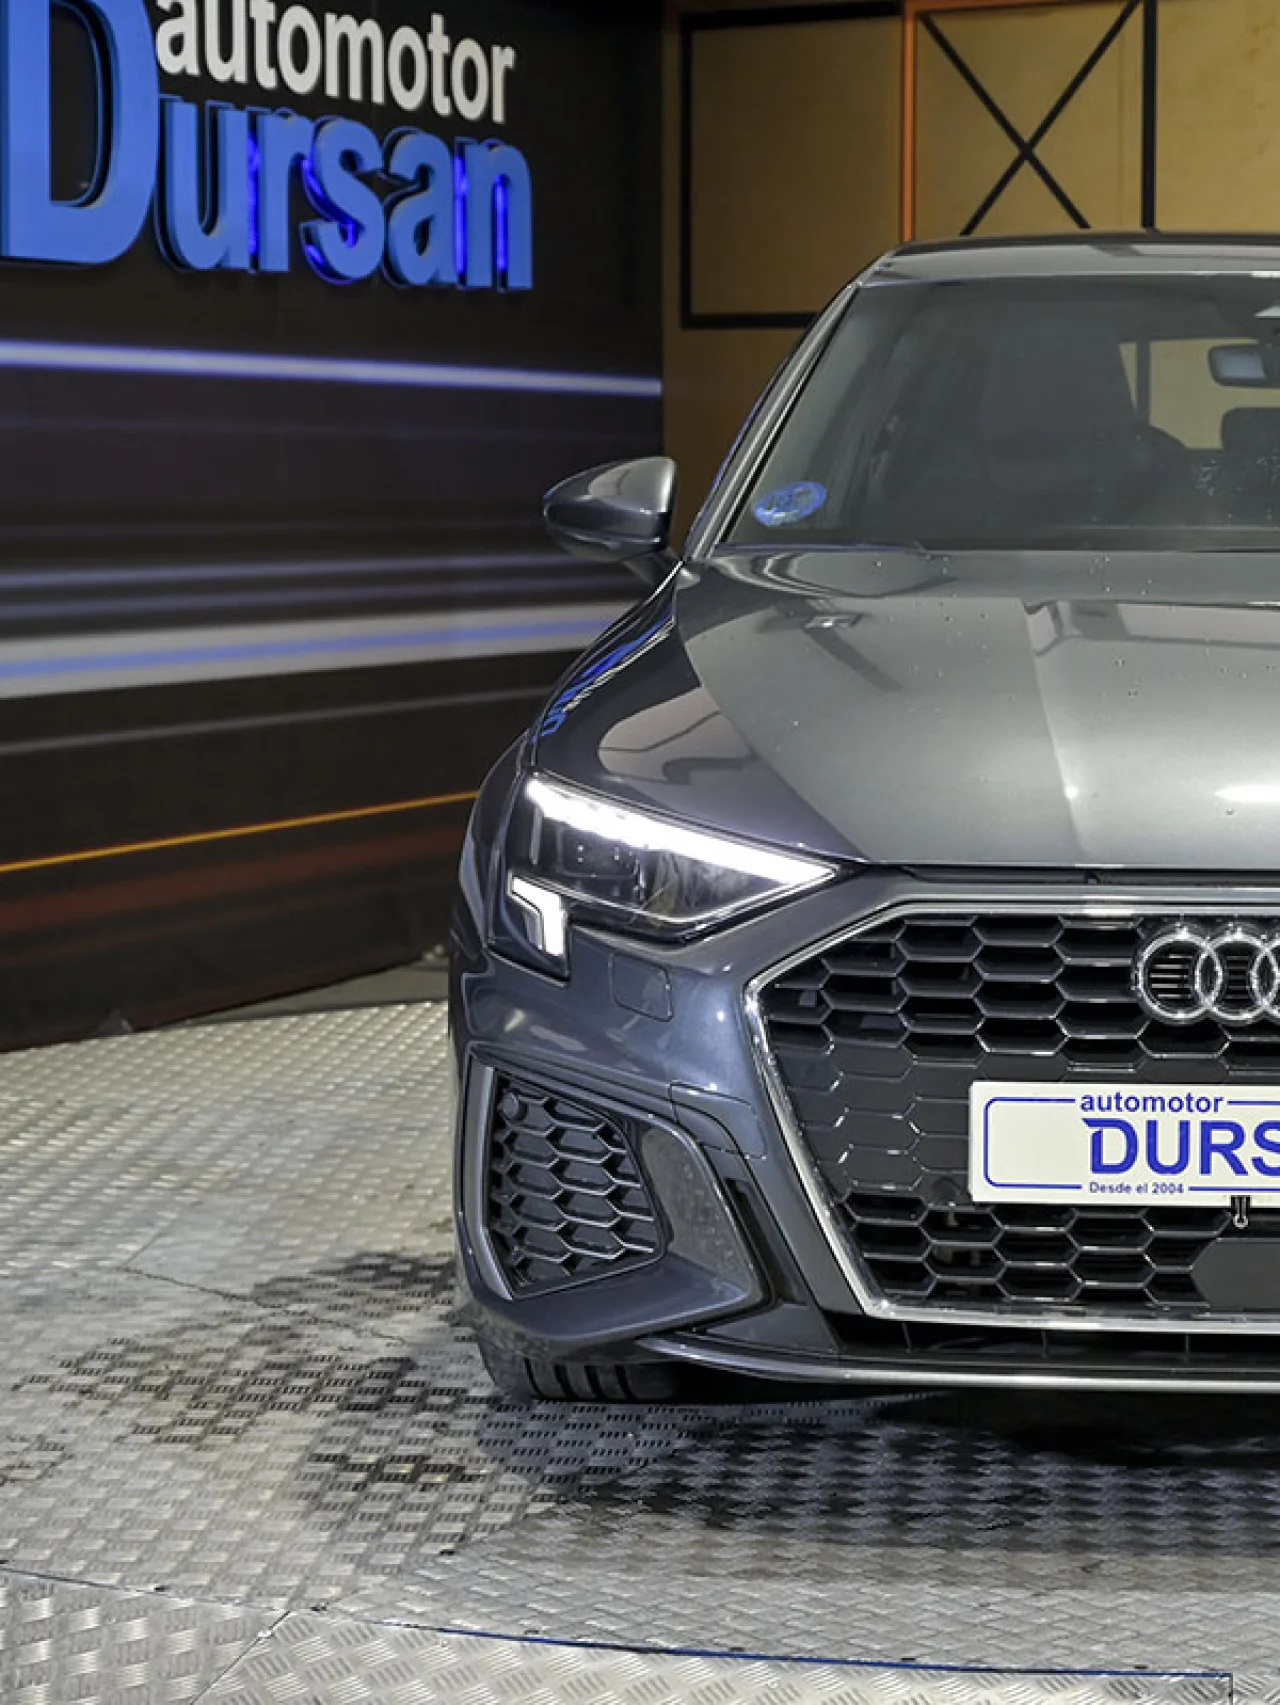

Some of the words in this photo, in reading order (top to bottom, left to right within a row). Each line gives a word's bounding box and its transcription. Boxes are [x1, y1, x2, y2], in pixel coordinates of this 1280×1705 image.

[155, 0, 516, 123] automotor
[0, 0, 533, 290] Dursan
[1080, 1092, 1224, 1113] automotor
[1089, 1181, 1131, 1194] Desde
[1136, 1183, 1148, 1194] el
[1151, 1182, 1185, 1195] 2004
